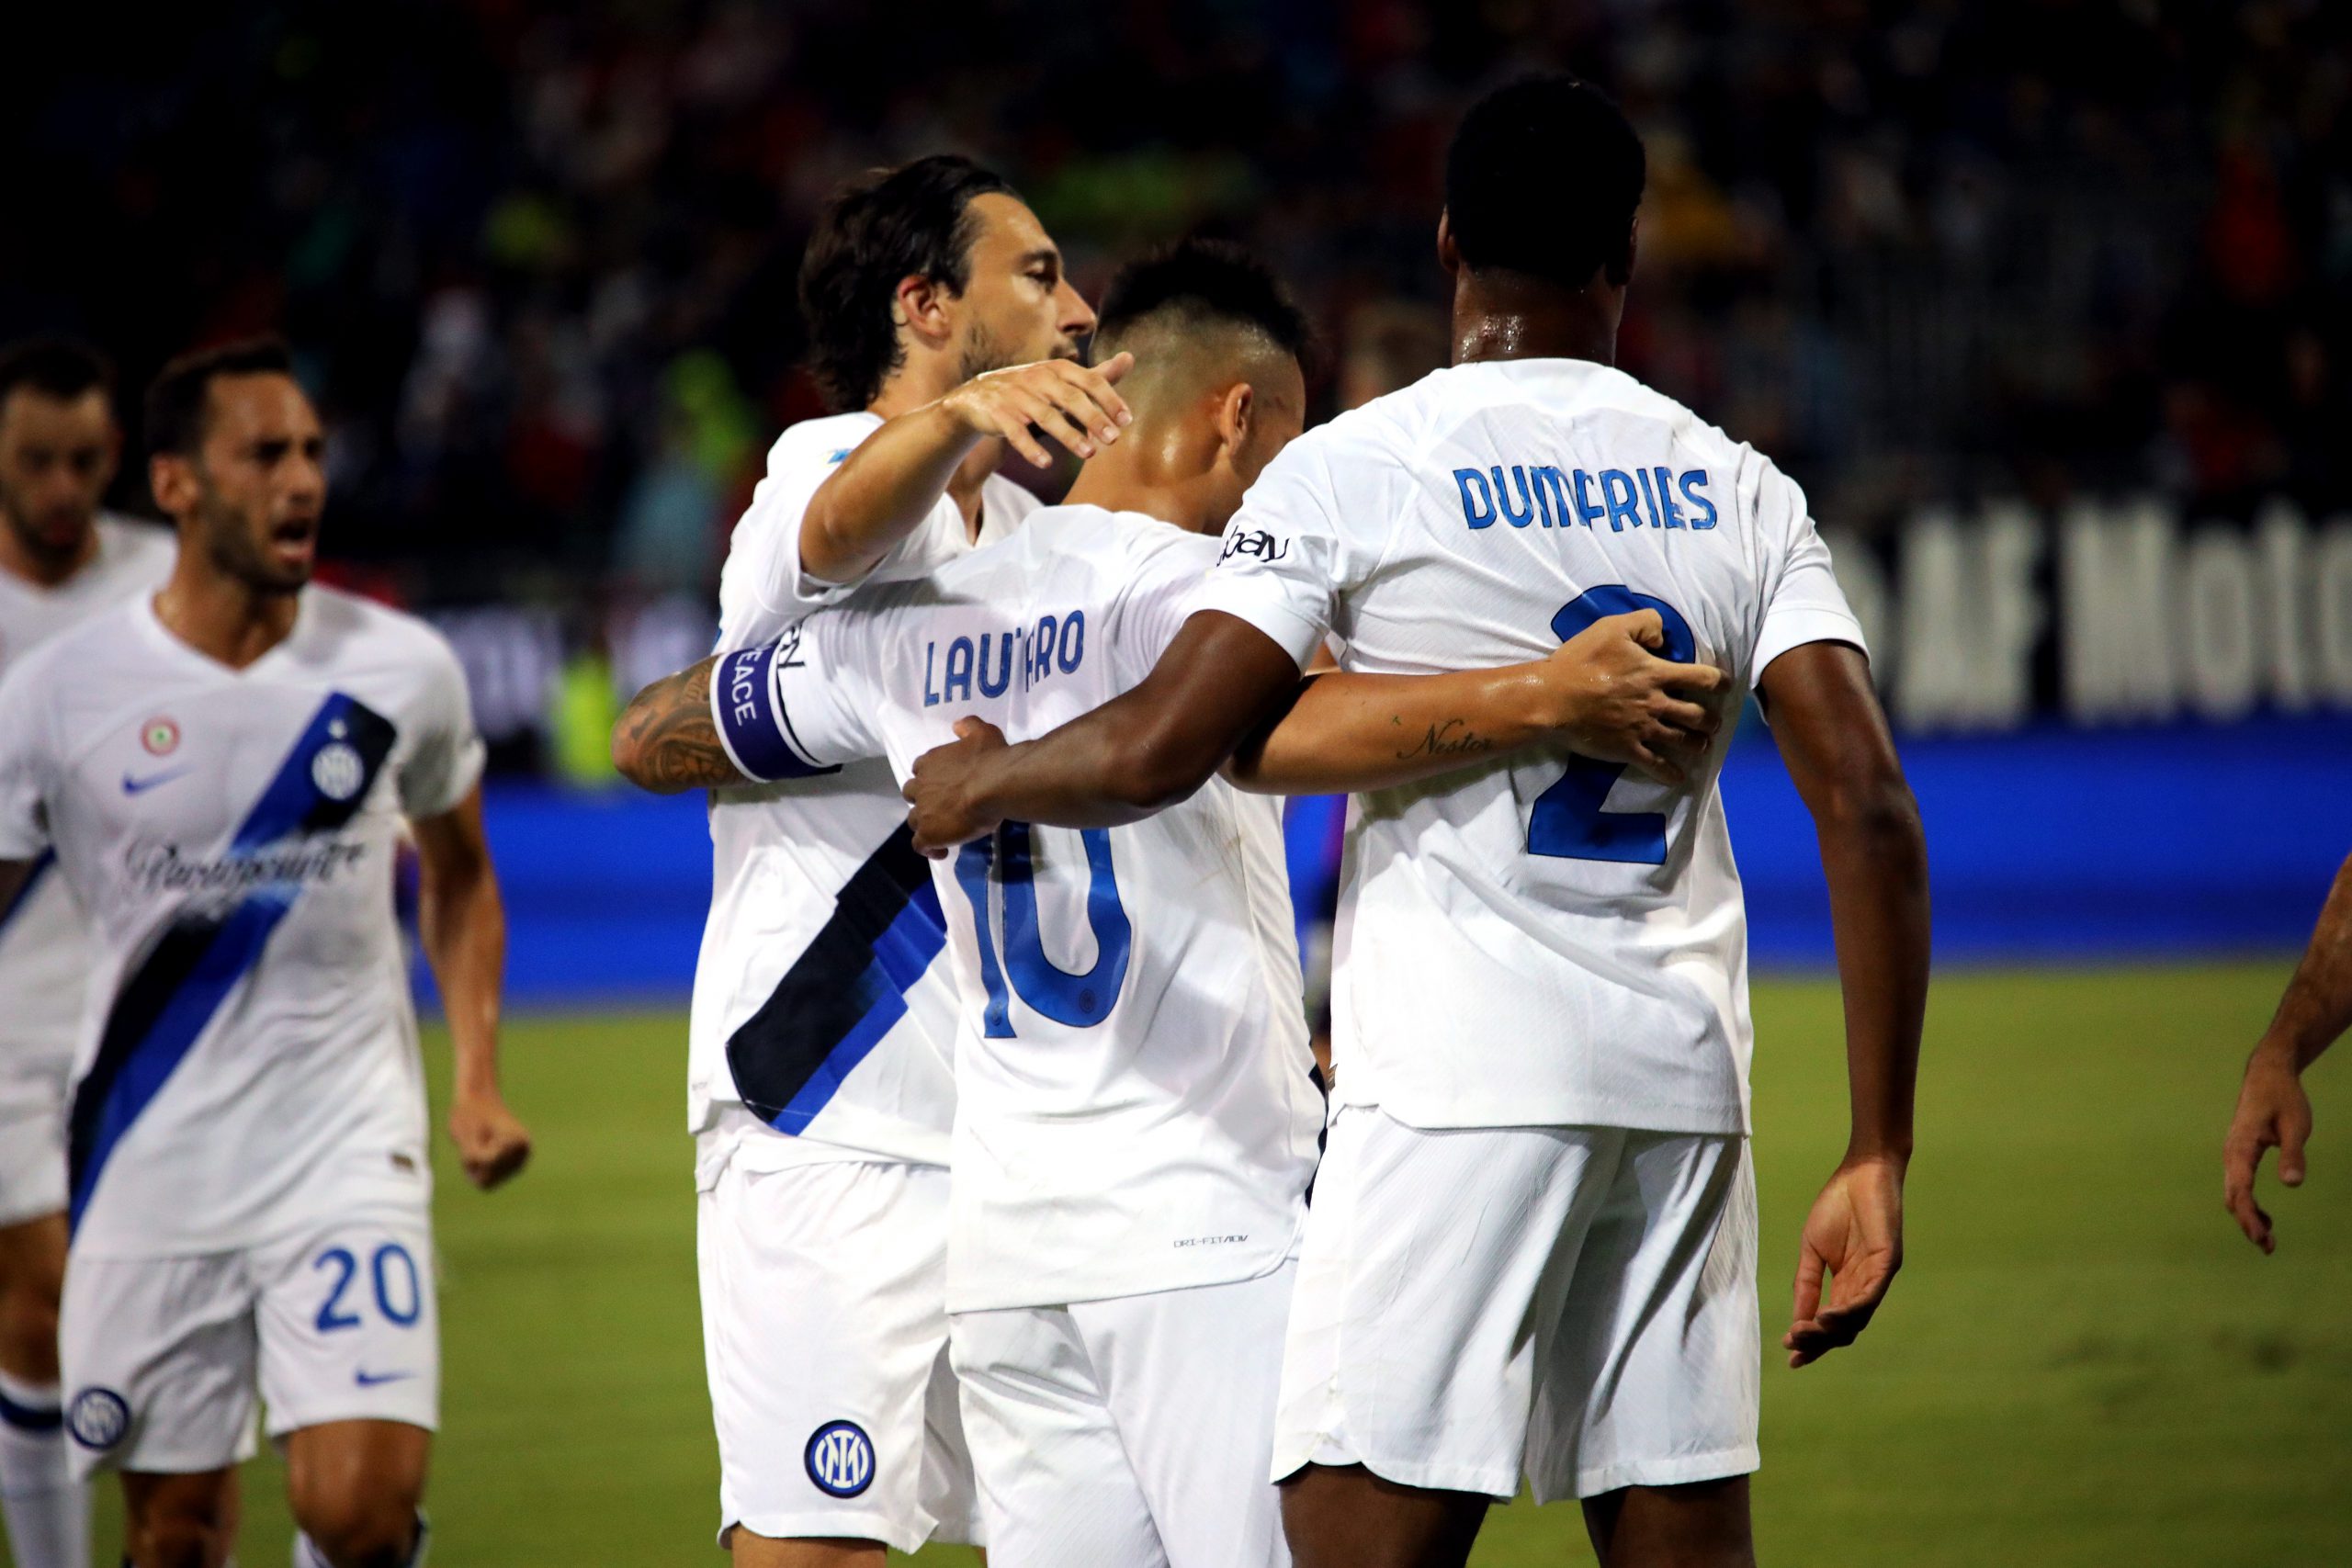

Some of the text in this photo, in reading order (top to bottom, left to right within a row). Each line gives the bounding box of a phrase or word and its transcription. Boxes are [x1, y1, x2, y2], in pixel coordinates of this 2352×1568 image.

[1453, 465, 1717, 532] DUMFRIES
[731, 649, 763, 727] EACE
[924, 610, 1085, 707] LAUARO
[955, 819, 1131, 1038] 10
[314, 1244, 420, 1332] 20
